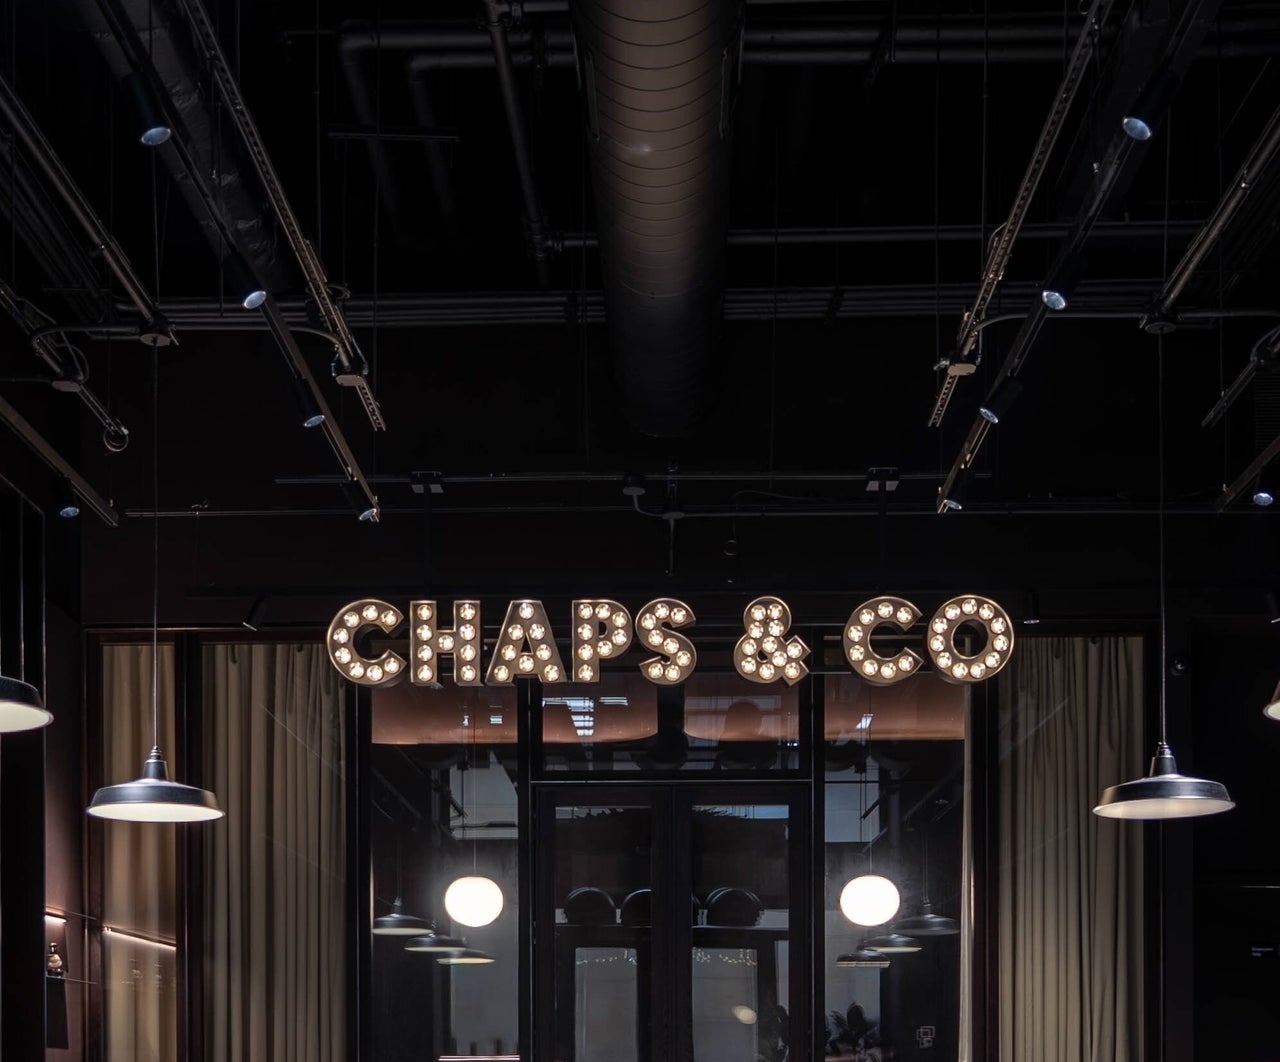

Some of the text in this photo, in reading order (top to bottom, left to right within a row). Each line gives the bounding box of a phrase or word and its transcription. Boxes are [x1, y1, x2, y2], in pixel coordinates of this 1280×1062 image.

[326, 594, 1015, 687] CHAPS & CO
